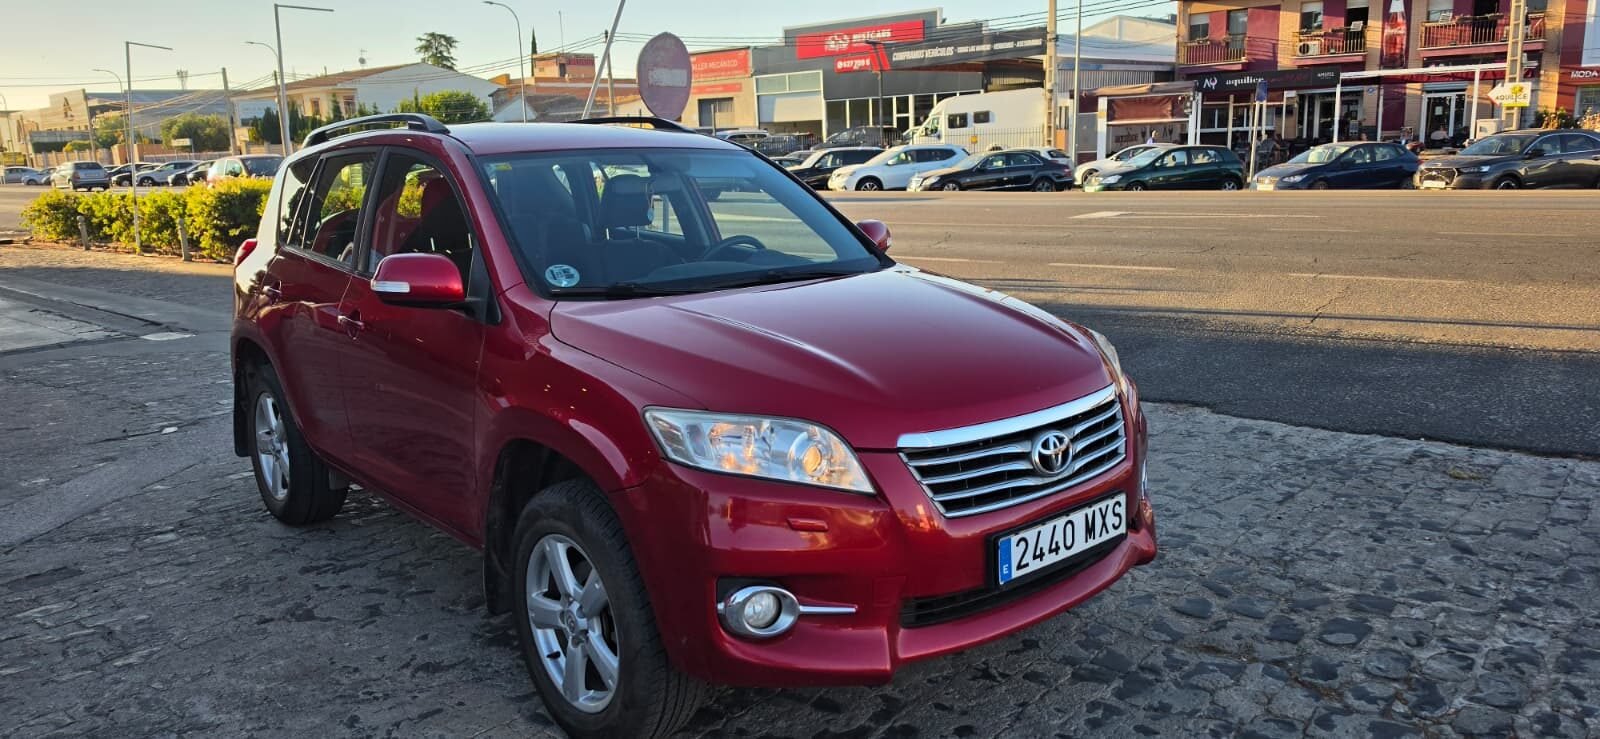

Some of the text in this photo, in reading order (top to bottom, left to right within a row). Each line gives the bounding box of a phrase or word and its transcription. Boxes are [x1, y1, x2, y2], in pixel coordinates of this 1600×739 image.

[1571, 70, 1599, 79] MODA
[1015, 500, 1122, 571] 2440 MXS
[1002, 564, 1009, 574] E
